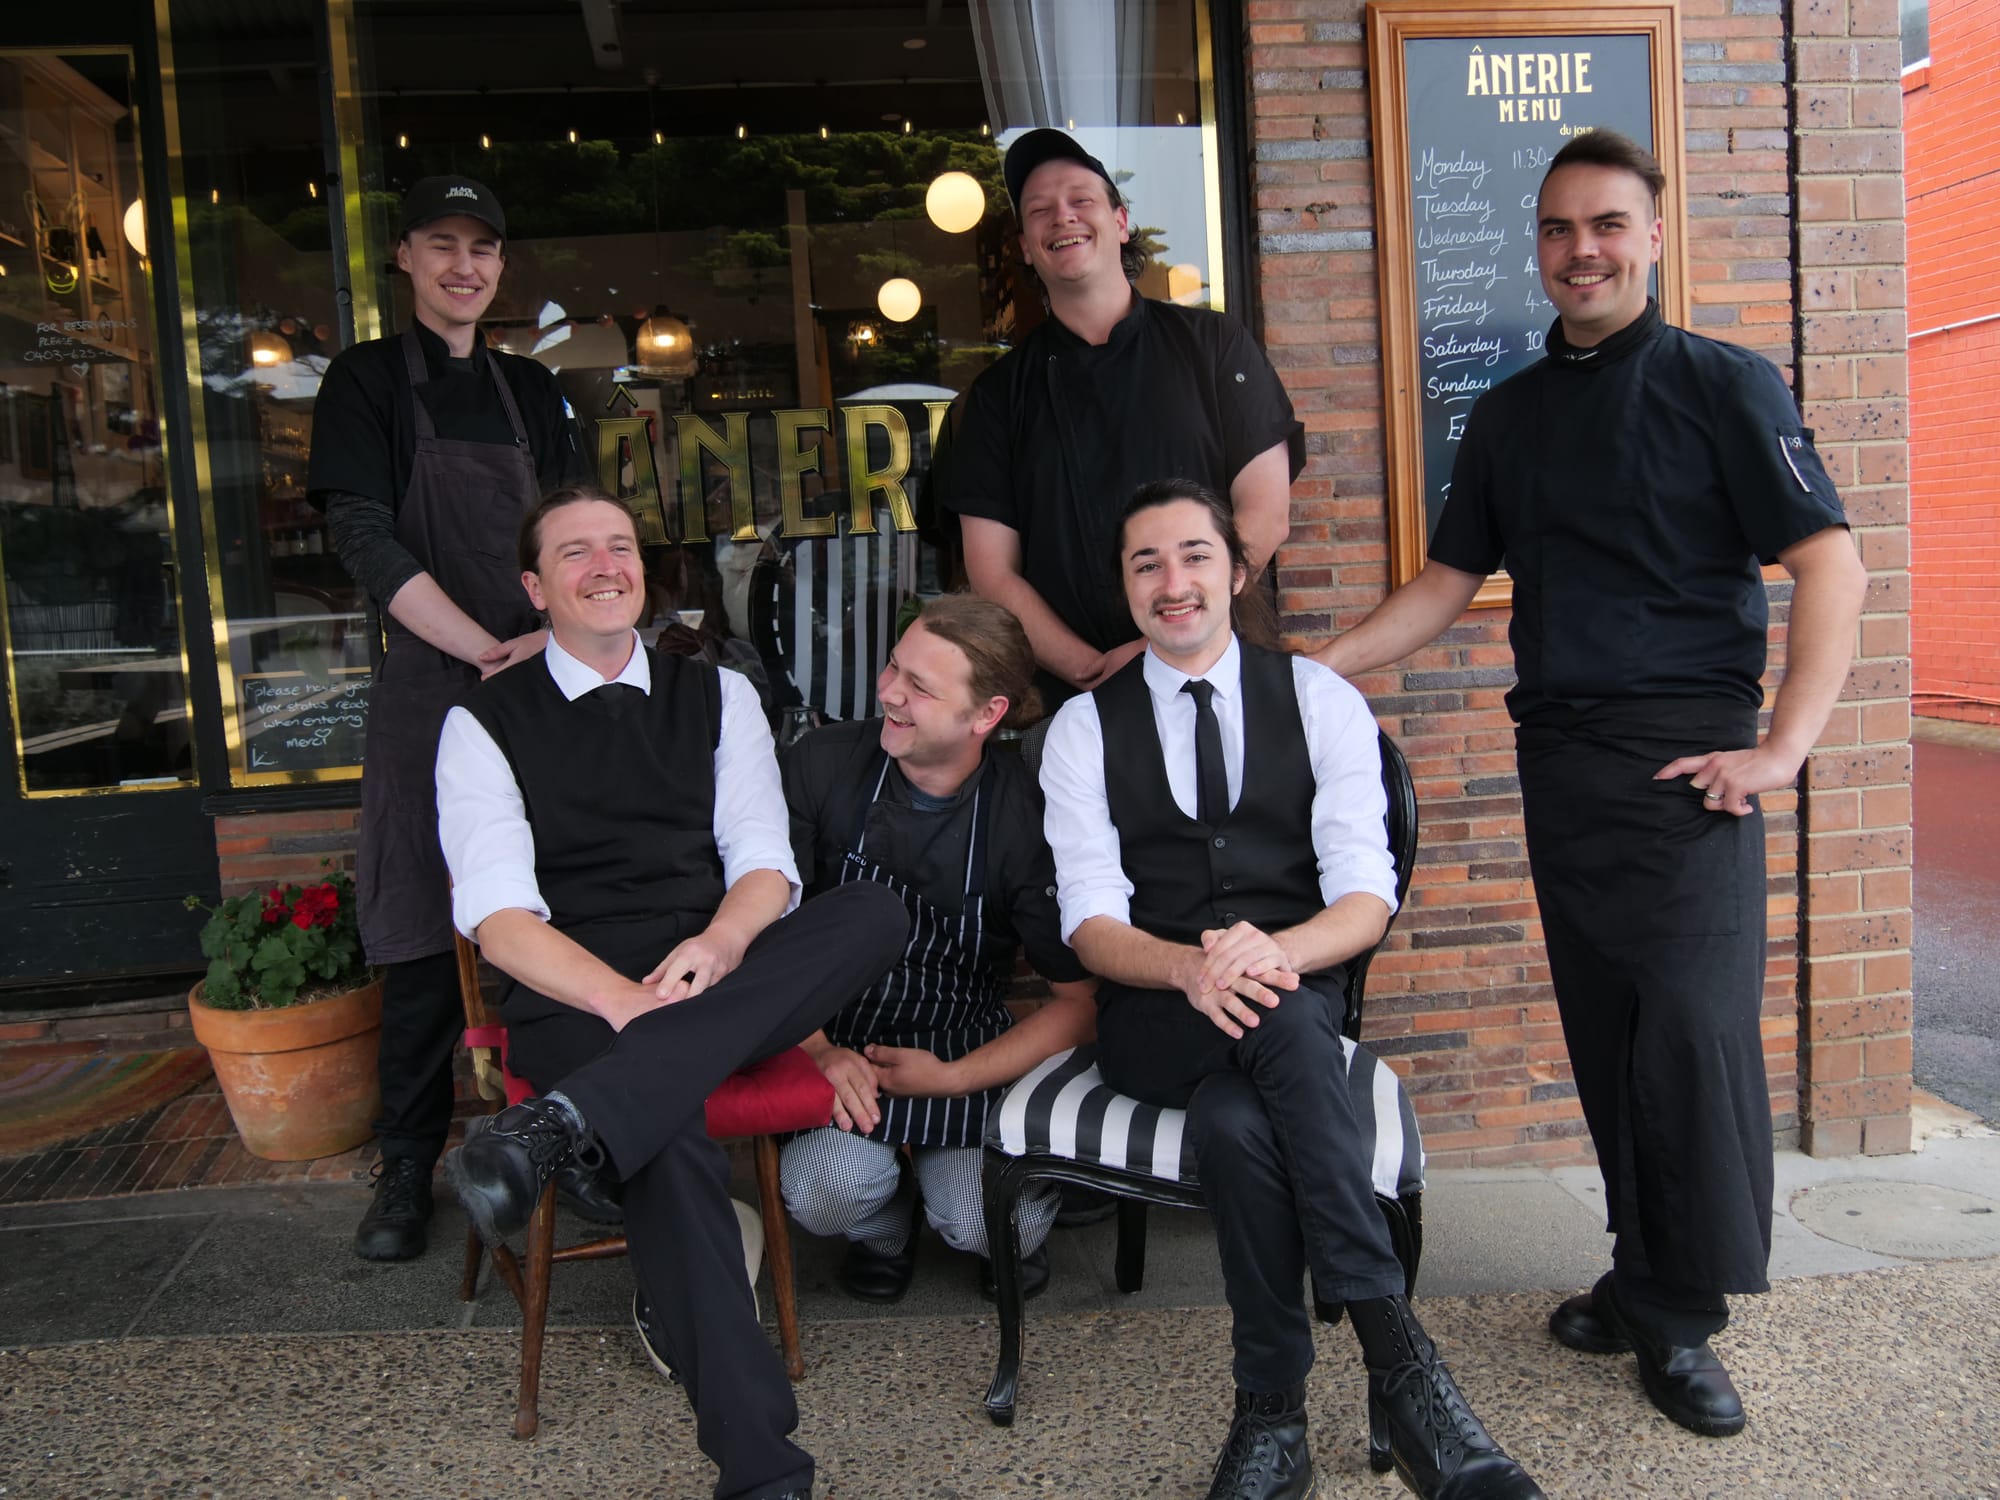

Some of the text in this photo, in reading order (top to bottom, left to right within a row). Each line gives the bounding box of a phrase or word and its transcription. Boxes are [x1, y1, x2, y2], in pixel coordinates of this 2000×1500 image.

[1467, 45, 1593, 96] ÂNERIE
[1499, 98, 1562, 122] MENU
[1559, 123, 1571, 136] du
[1415, 147, 1492, 190] Monday
[1417, 191, 1496, 223] Tuesday
[1418, 225, 1508, 255] Wednesday
[1421, 258, 1508, 290] Thursday
[1423, 293, 1495, 325] Friday
[36, 321, 61, 334] FOR
[1423, 333, 1509, 366] Saturday
[595, 383, 952, 545] ÂNER
[254, 684, 301, 704] please
